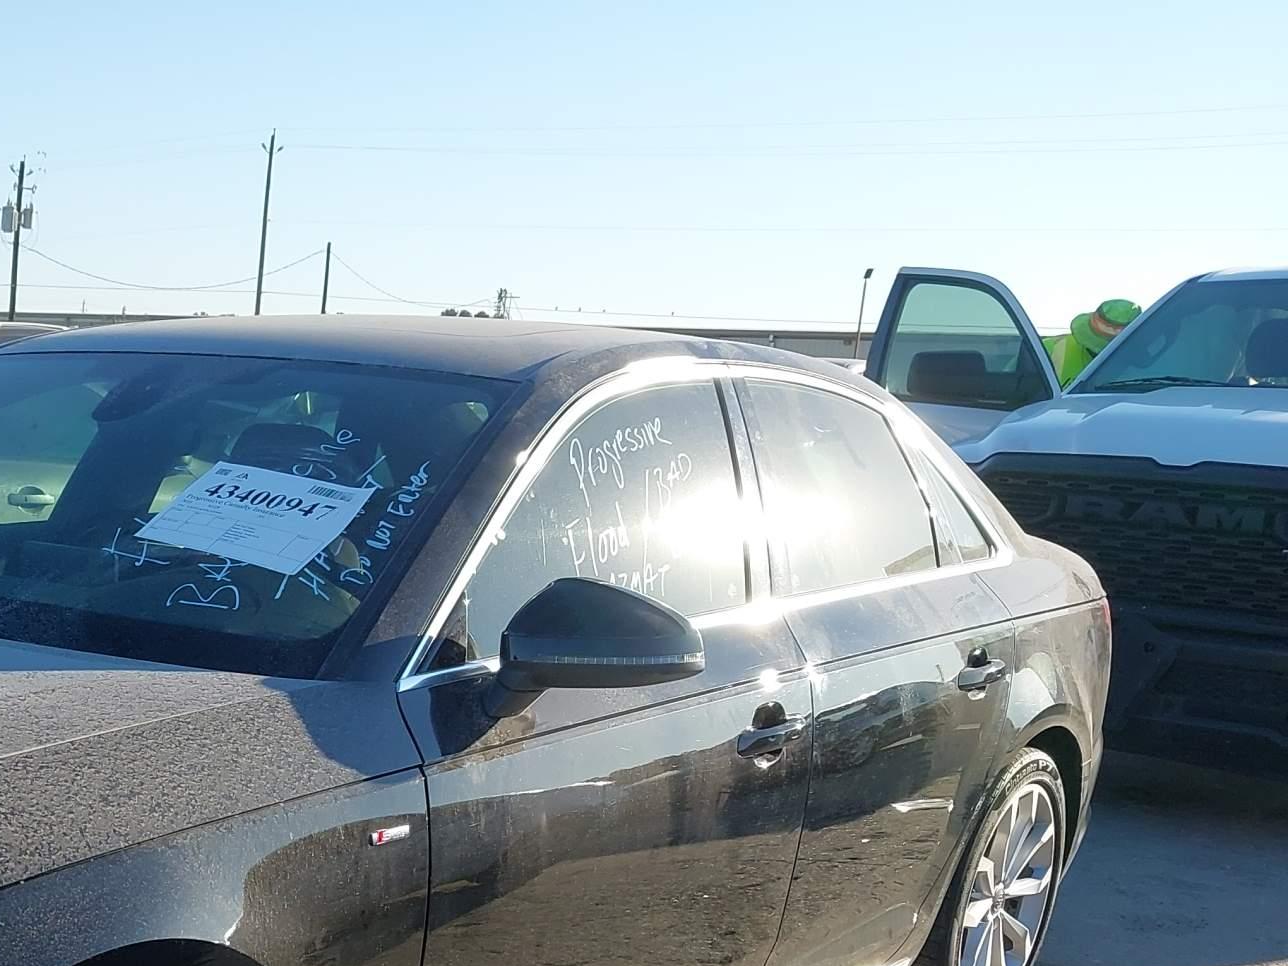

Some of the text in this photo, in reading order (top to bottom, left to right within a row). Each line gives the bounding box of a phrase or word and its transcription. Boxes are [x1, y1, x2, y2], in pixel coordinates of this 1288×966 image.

[569, 417, 672, 490] Progressive
[653, 453, 693, 512] BAD
[204, 482, 338, 521] 43400947
[562, 502, 630, 577] Flood
